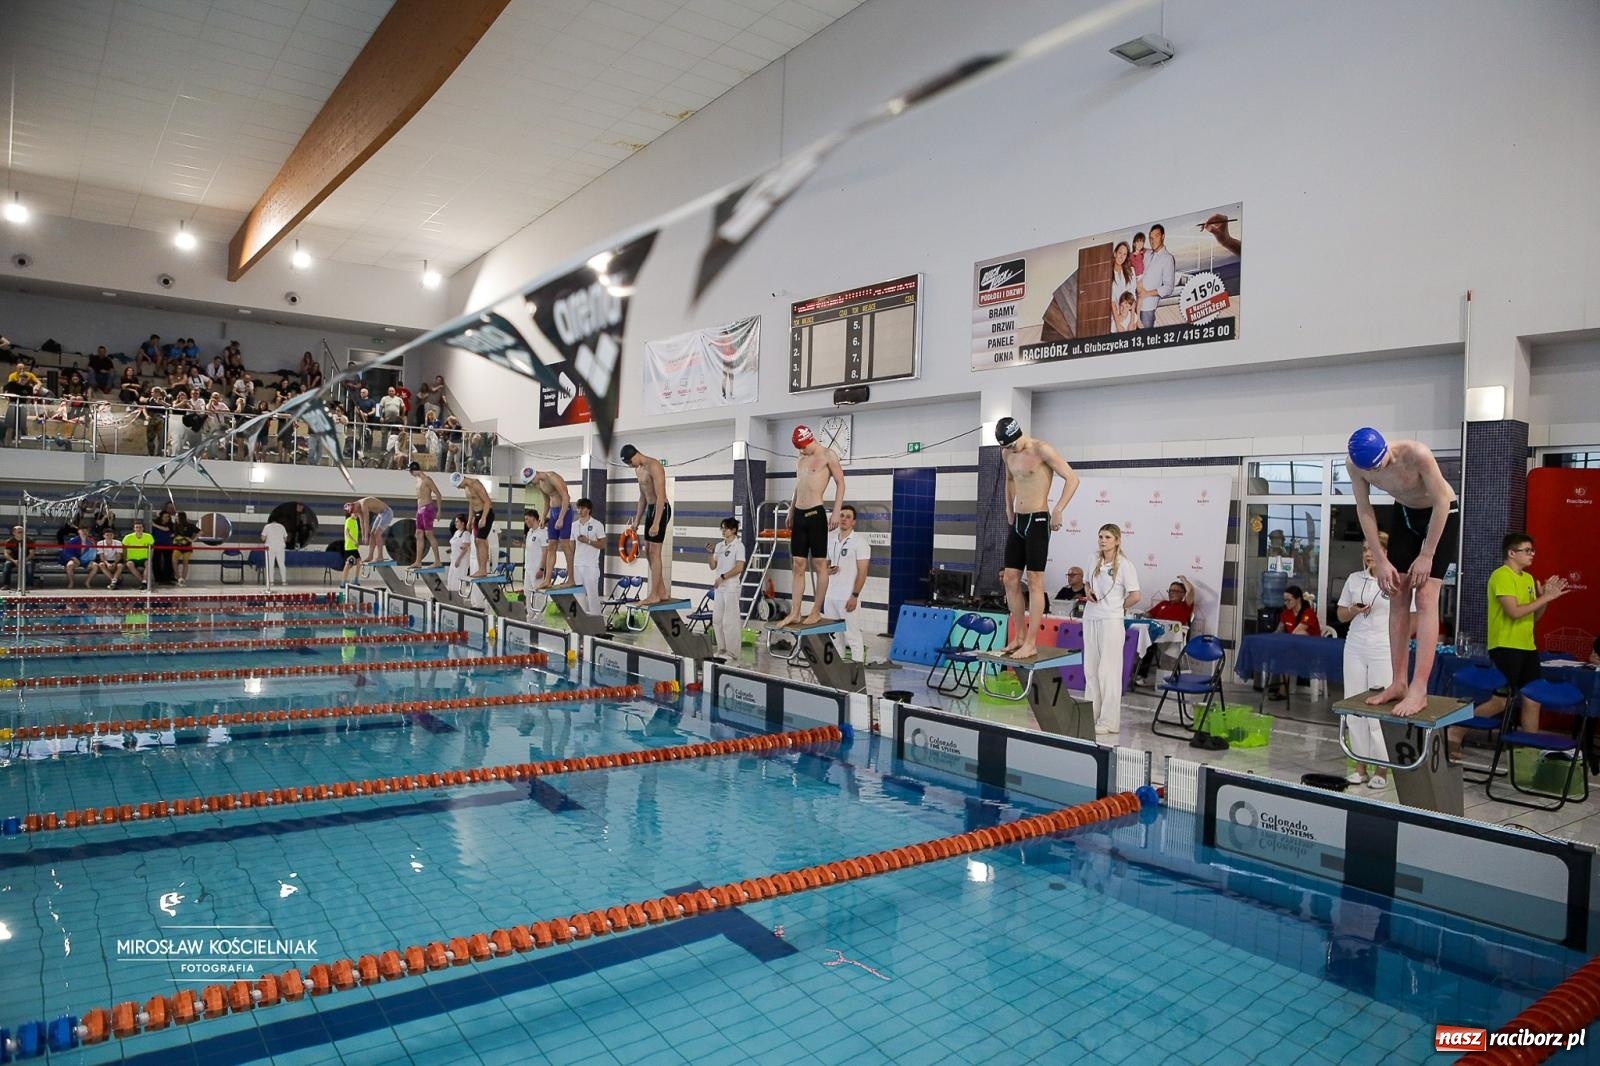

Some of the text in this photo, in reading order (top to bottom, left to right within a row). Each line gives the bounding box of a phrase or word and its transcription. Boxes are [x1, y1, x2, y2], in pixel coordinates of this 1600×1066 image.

[1186, 279, 1220, 302] -15%
[989, 305, 1015, 319] BRAMY
[992, 321, 1015, 333] DRZWI
[988, 335, 1014, 349] PANELE
[1022, 343, 1069, 361] RACIBÓRZ
[1072, 345, 1082, 355] ul.
[1131, 336, 1145, 348] 13,
[1147, 333, 1161, 346] tel:
[1163, 332, 1175, 344] 32
[1182, 328, 1201, 341] 415
[1202, 327, 1215, 339] 25
[1217, 325, 1230, 337] 00
[994, 351, 1014, 363] OKNA
[434, 578, 442, 592] 2
[569, 600, 577, 618] 4
[671, 618, 681, 638] 5
[824, 641, 834, 665] 6
[1053, 676, 1063, 707] 7
[1431, 735, 1440, 773] 8
[1260, 812, 1308, 831] Colorado
